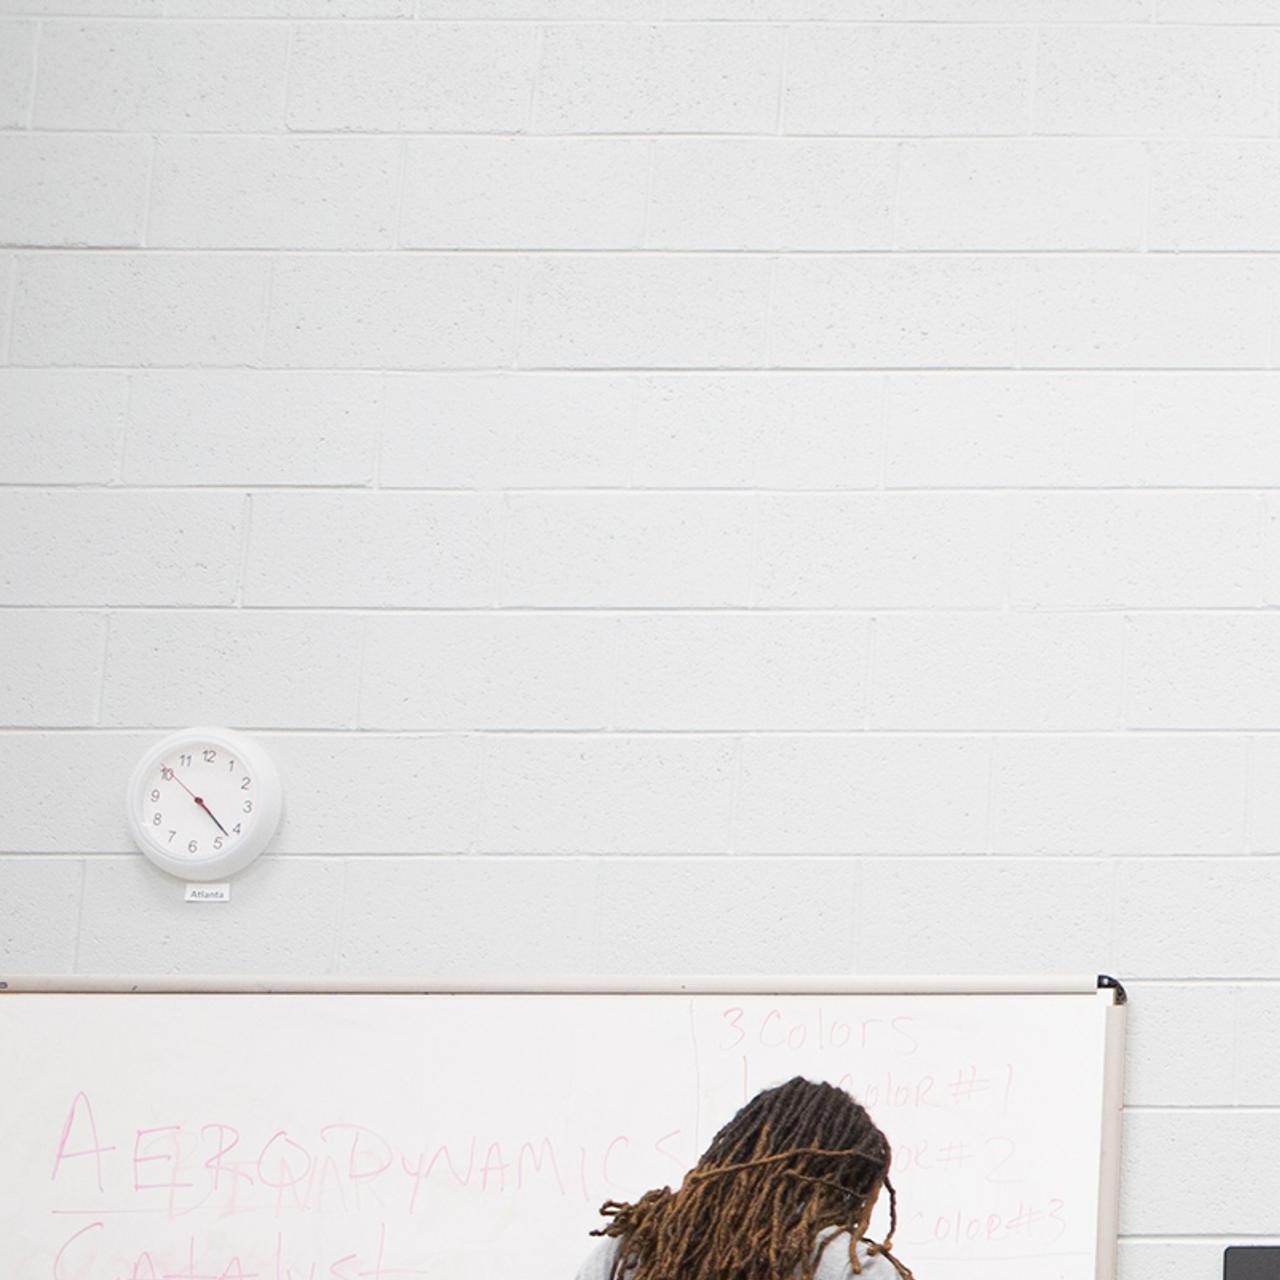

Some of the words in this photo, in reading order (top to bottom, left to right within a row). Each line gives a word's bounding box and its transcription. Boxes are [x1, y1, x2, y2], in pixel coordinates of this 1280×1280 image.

[180, 754, 192, 767] 11
[203, 750, 217, 763] 12
[229, 759, 235, 772] 1
[160, 767, 174, 781] 10
[240, 776, 251, 791] 2
[151, 789, 160, 802] 9
[243, 801, 253, 814] 3
[153, 813, 162, 826] 8
[233, 823, 241, 835] 4
[168, 831, 176, 843] 7
[213, 836, 223, 849] 5
[188, 840, 198, 853] 6
[190, 890, 225, 899] Atlanta
[720, 1007, 746, 1050] 3
